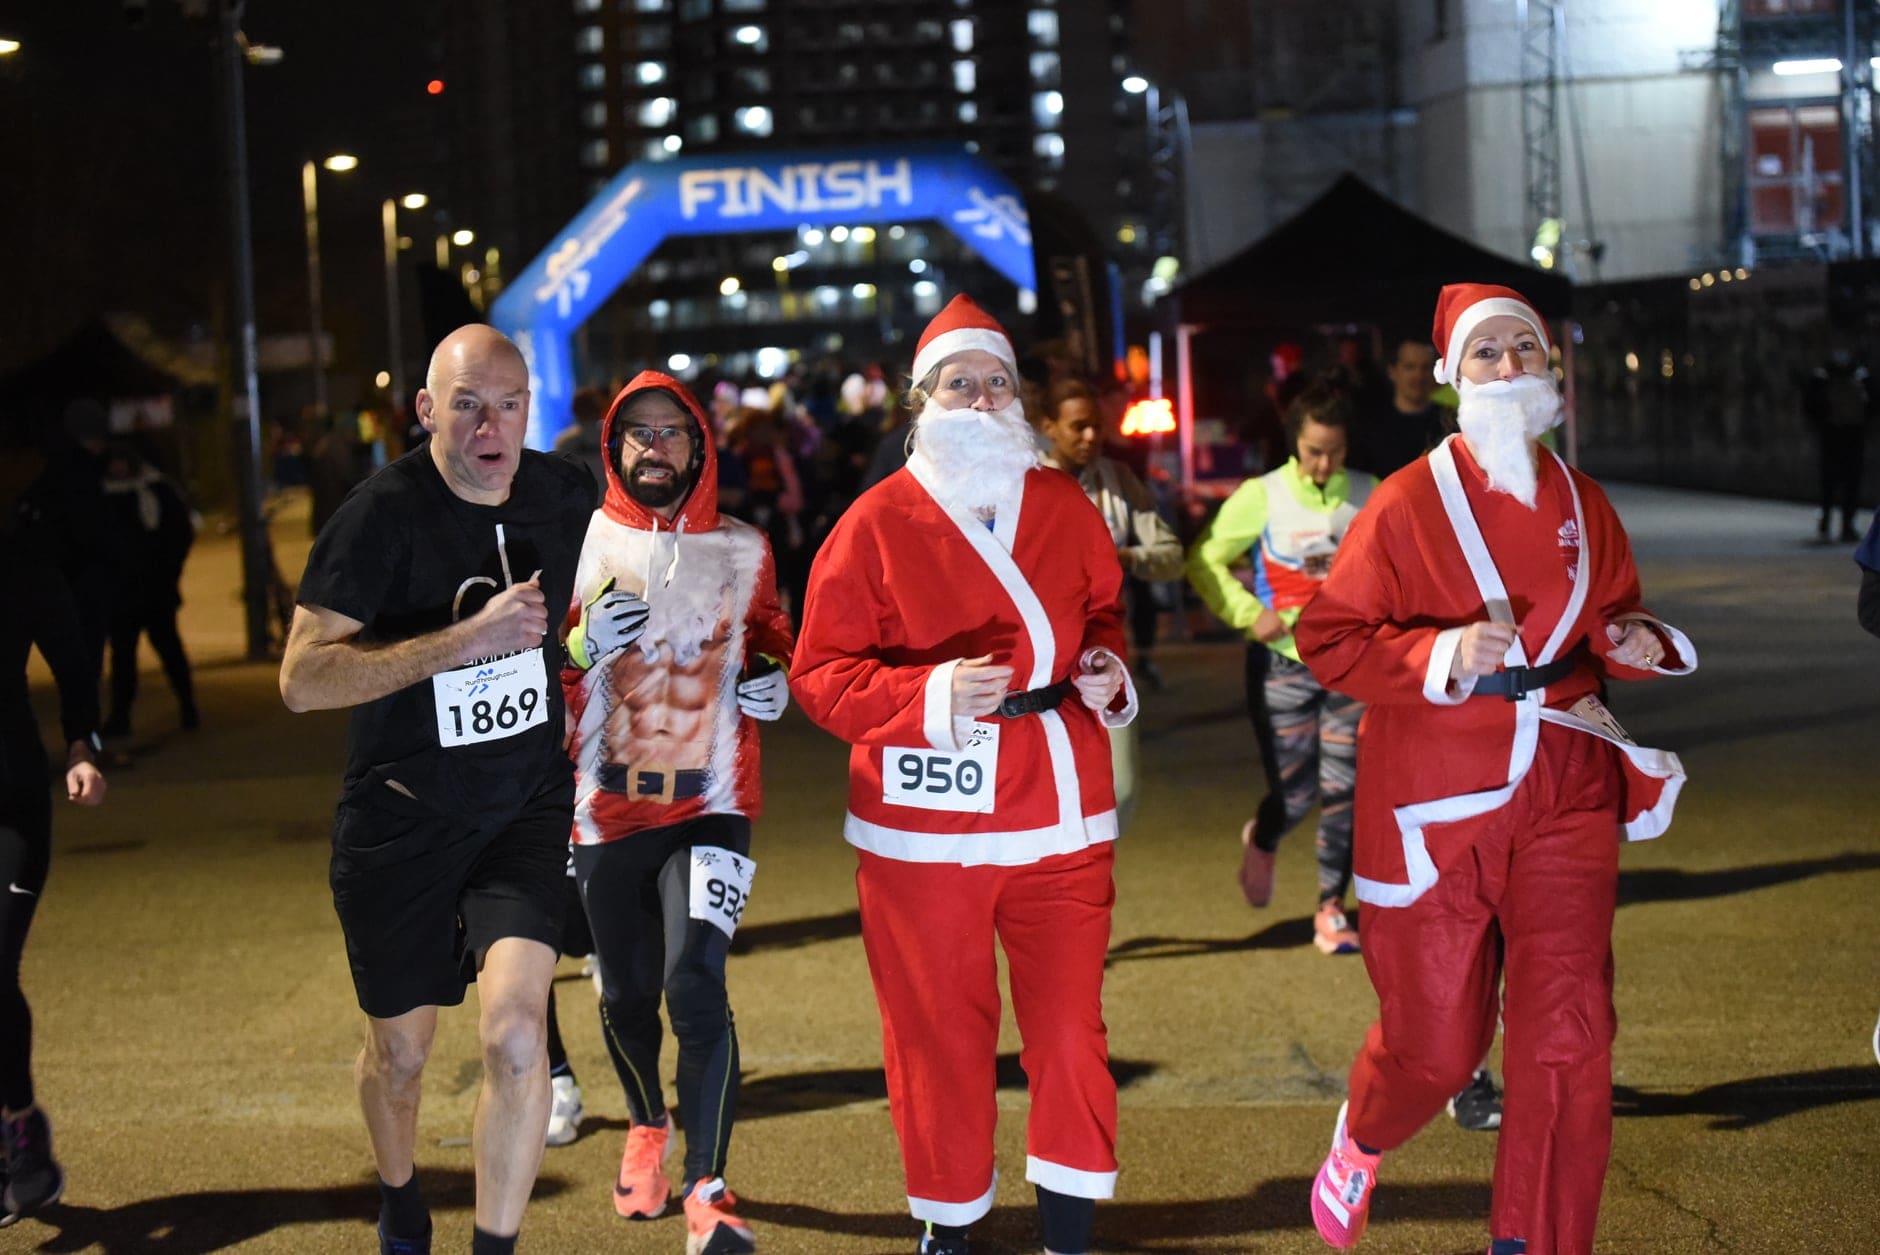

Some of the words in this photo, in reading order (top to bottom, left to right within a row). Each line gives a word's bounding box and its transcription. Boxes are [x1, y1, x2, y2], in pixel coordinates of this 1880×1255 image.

[679, 159, 913, 220] FINISH
[448, 687, 539, 737] 1869
[898, 753, 983, 796] 950
